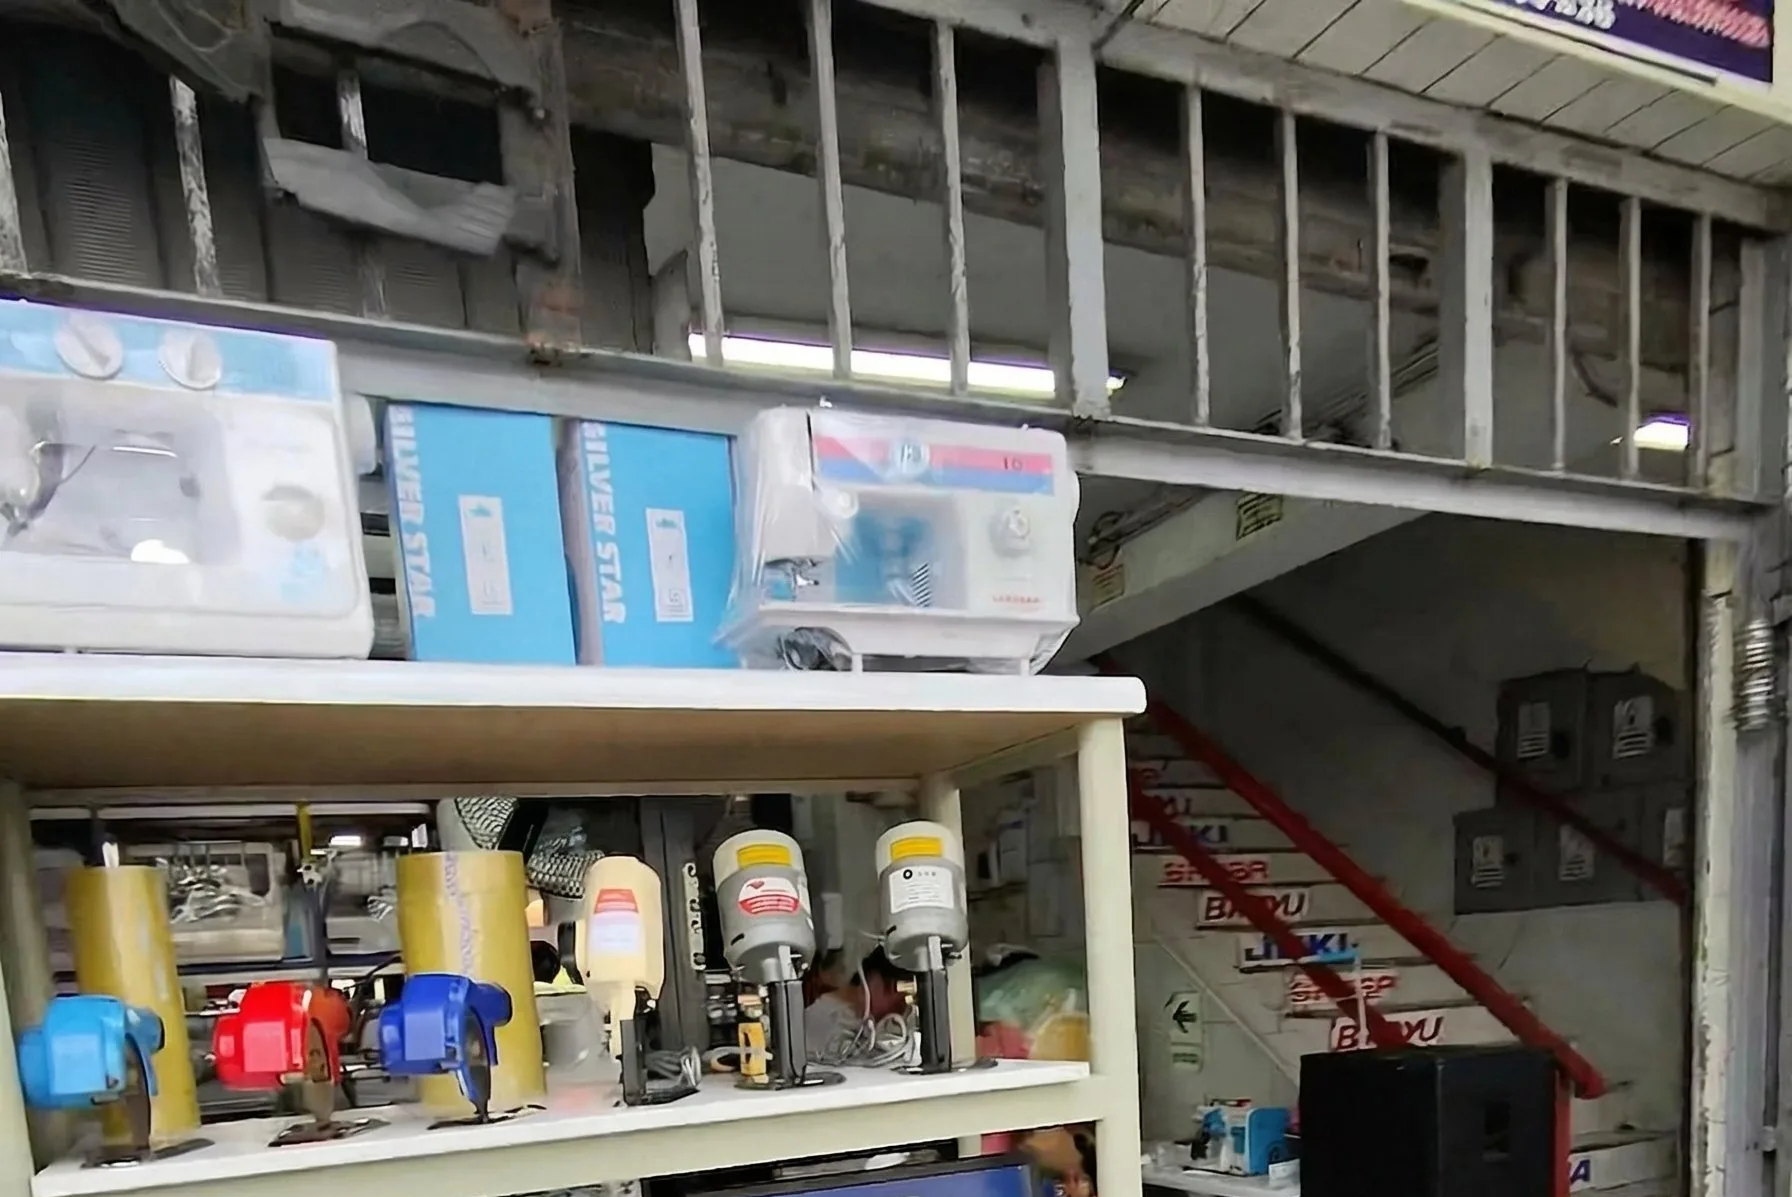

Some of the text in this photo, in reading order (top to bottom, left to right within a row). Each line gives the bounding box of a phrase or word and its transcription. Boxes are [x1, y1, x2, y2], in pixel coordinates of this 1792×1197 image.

[389, 406, 435, 617] SILVER STAR
[583, 421, 626, 623] SILVER STAR
[1245, 932, 1349, 962] JKI
